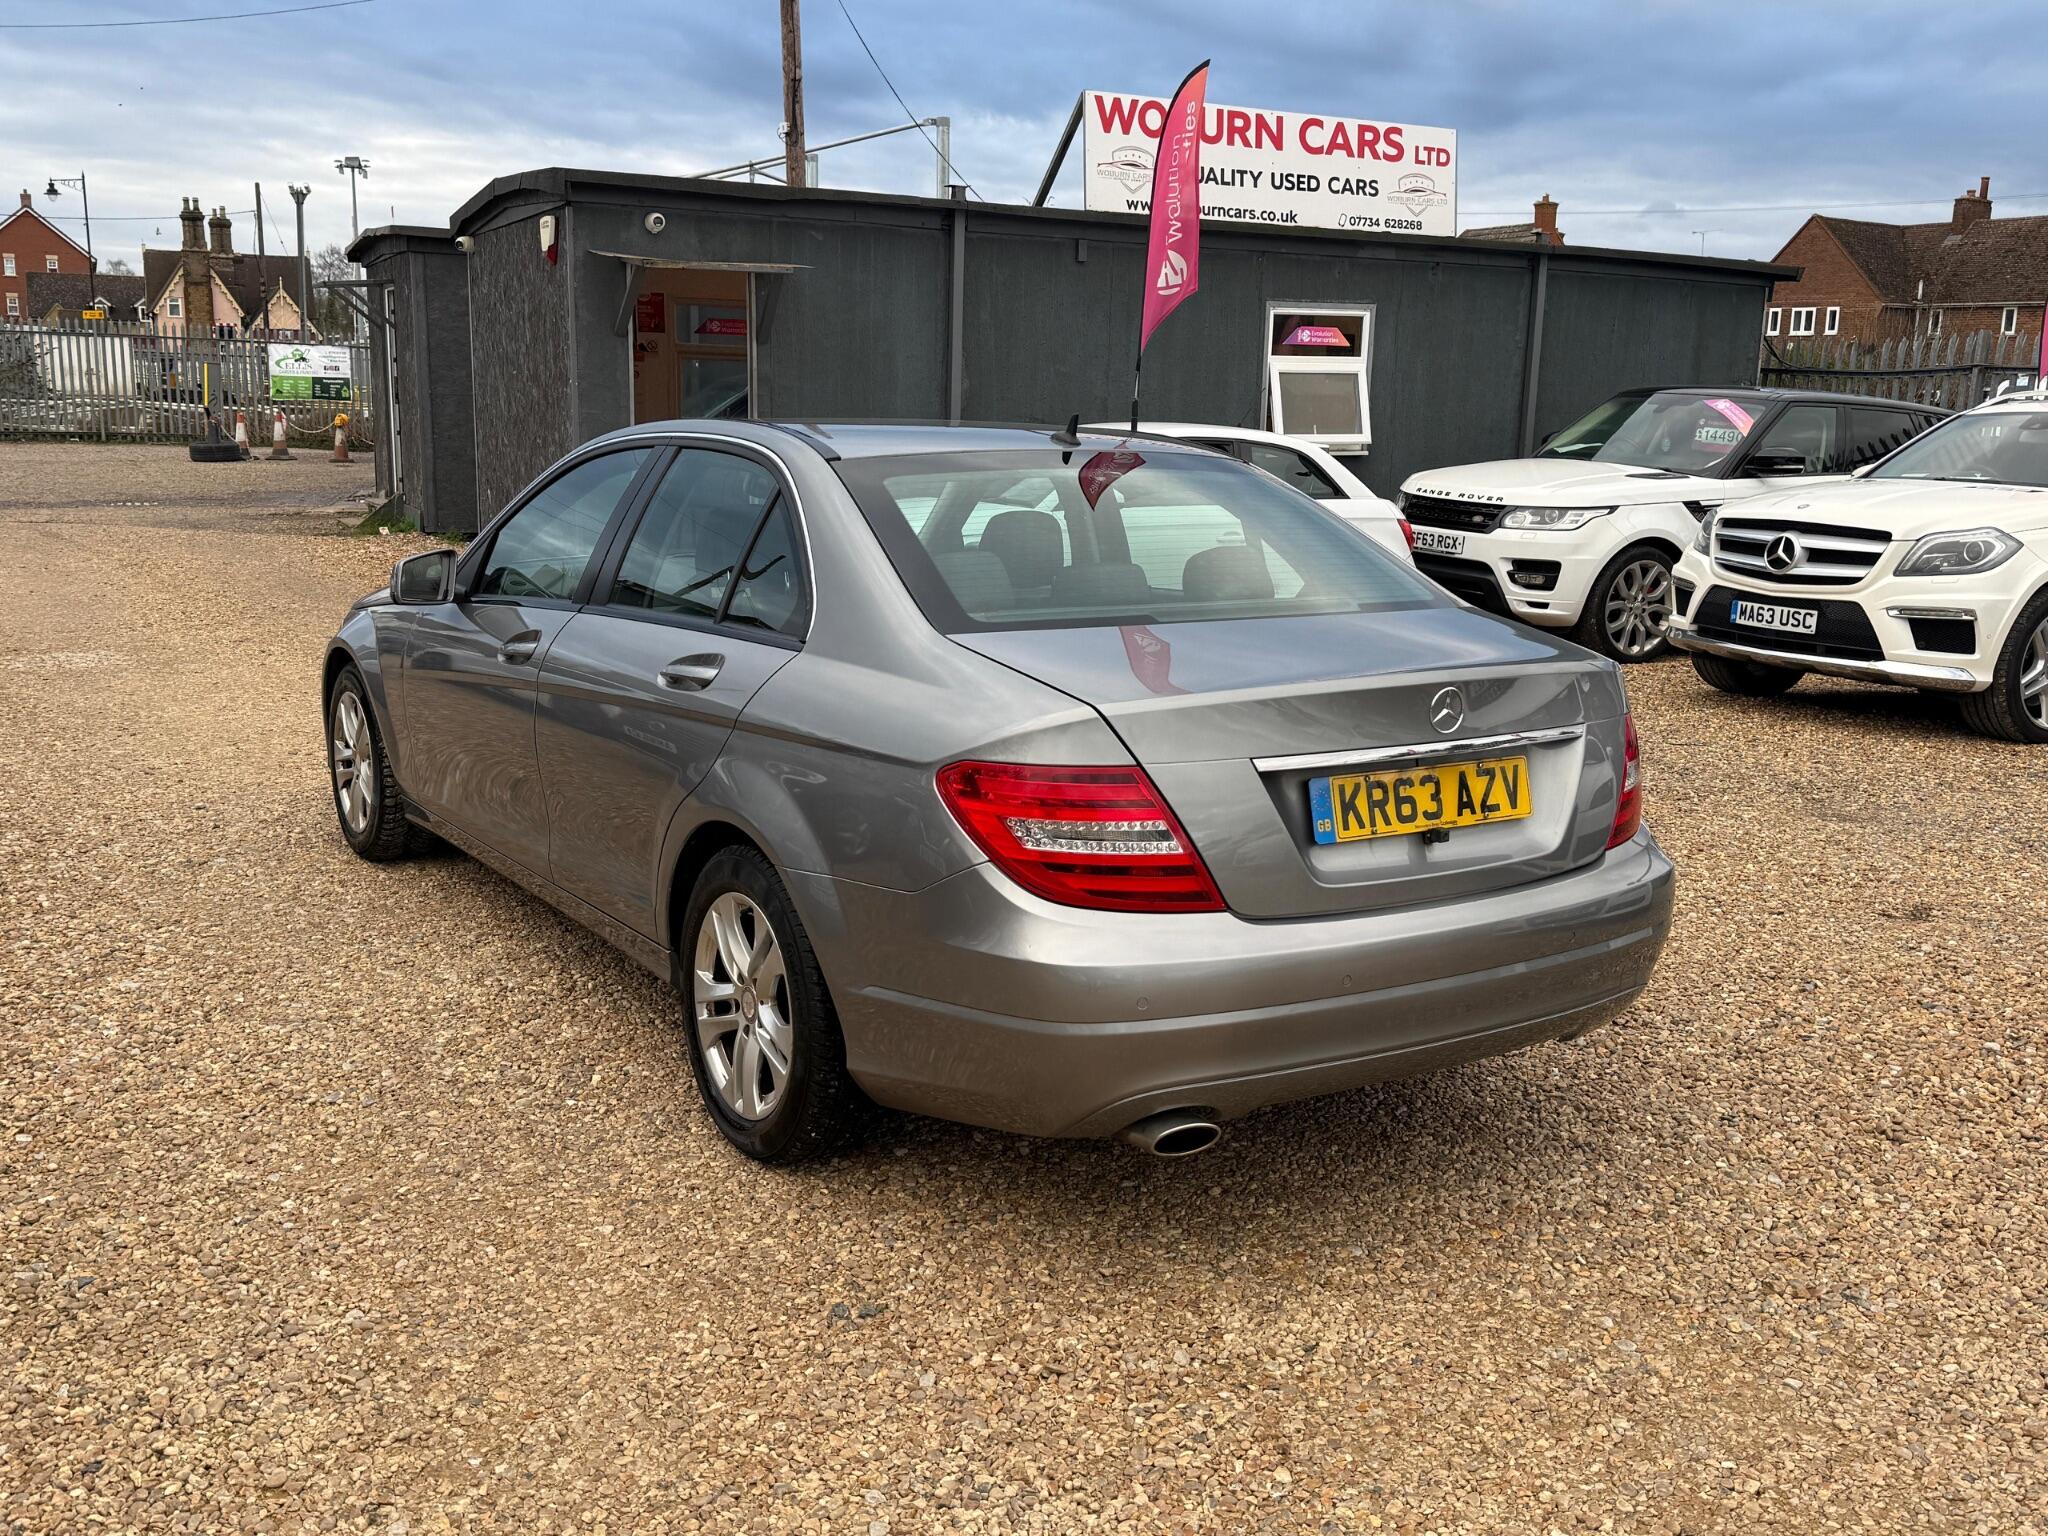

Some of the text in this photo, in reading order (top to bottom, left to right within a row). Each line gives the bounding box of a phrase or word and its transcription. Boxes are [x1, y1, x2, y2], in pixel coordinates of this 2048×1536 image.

[1094, 94, 1451, 167] WOURN CARS LTD
[1271, 172, 1320, 192] USED
[1328, 176, 1379, 197] CARS
[1417, 197, 1435, 207] CARS
[1349, 216, 1423, 230] 07734 628268
[1416, 487, 1504, 502] RANGE ROVER
[1437, 534, 1458, 550] RGX
[1739, 603, 1814, 629] MA63 USC
[1338, 764, 1519, 832] KR63 AZV
[1317, 818, 1332, 832] GB
